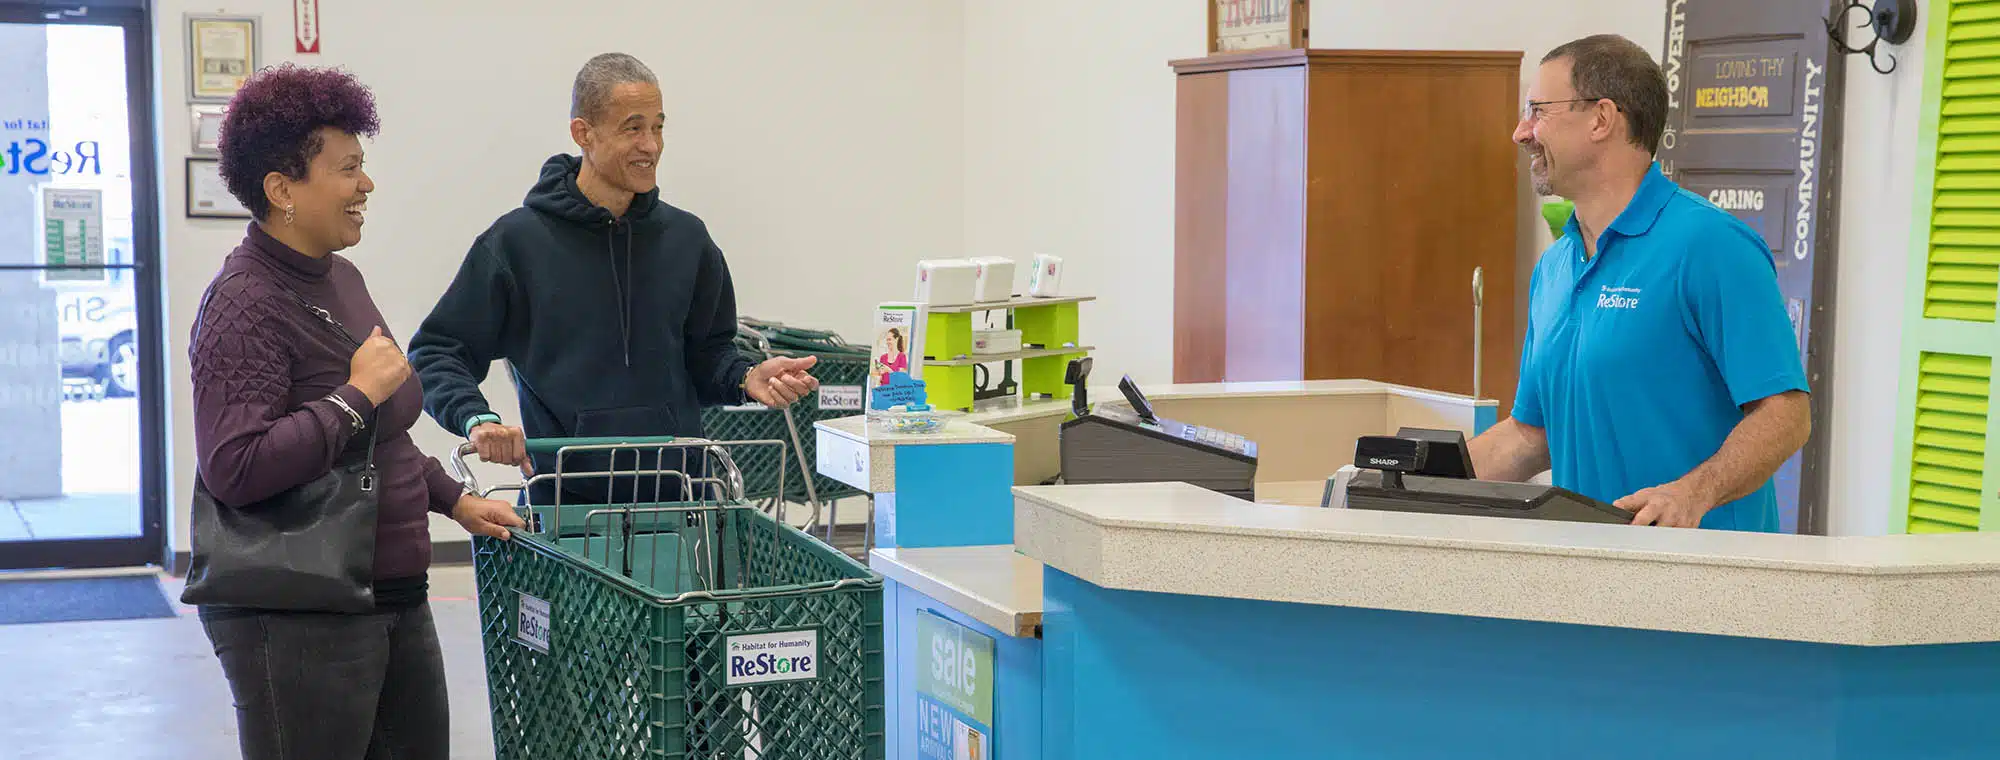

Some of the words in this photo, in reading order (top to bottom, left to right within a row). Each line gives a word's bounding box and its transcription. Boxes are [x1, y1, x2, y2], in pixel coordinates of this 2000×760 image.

[1715, 60, 1757, 79] LOVING
[1760, 58, 1785, 77] THY
[1695, 86, 1769, 108] NEIGHBOR
[1794, 57, 1823, 261] COMMUNITY
[1708, 189, 1765, 211] CARING
[1596, 293, 1639, 309] ReStore
[821, 394, 859, 406] ReStore
[1369, 457, 1399, 466] SHARP
[520, 612, 550, 643] ReStore
[741, 642, 766, 651] Habitat
[768, 641, 777, 649] for
[779, 639, 810, 648] Humanity
[731, 653, 812, 678] ReStore
[931, 632, 976, 696] sale
[919, 697, 953, 745] NEW
